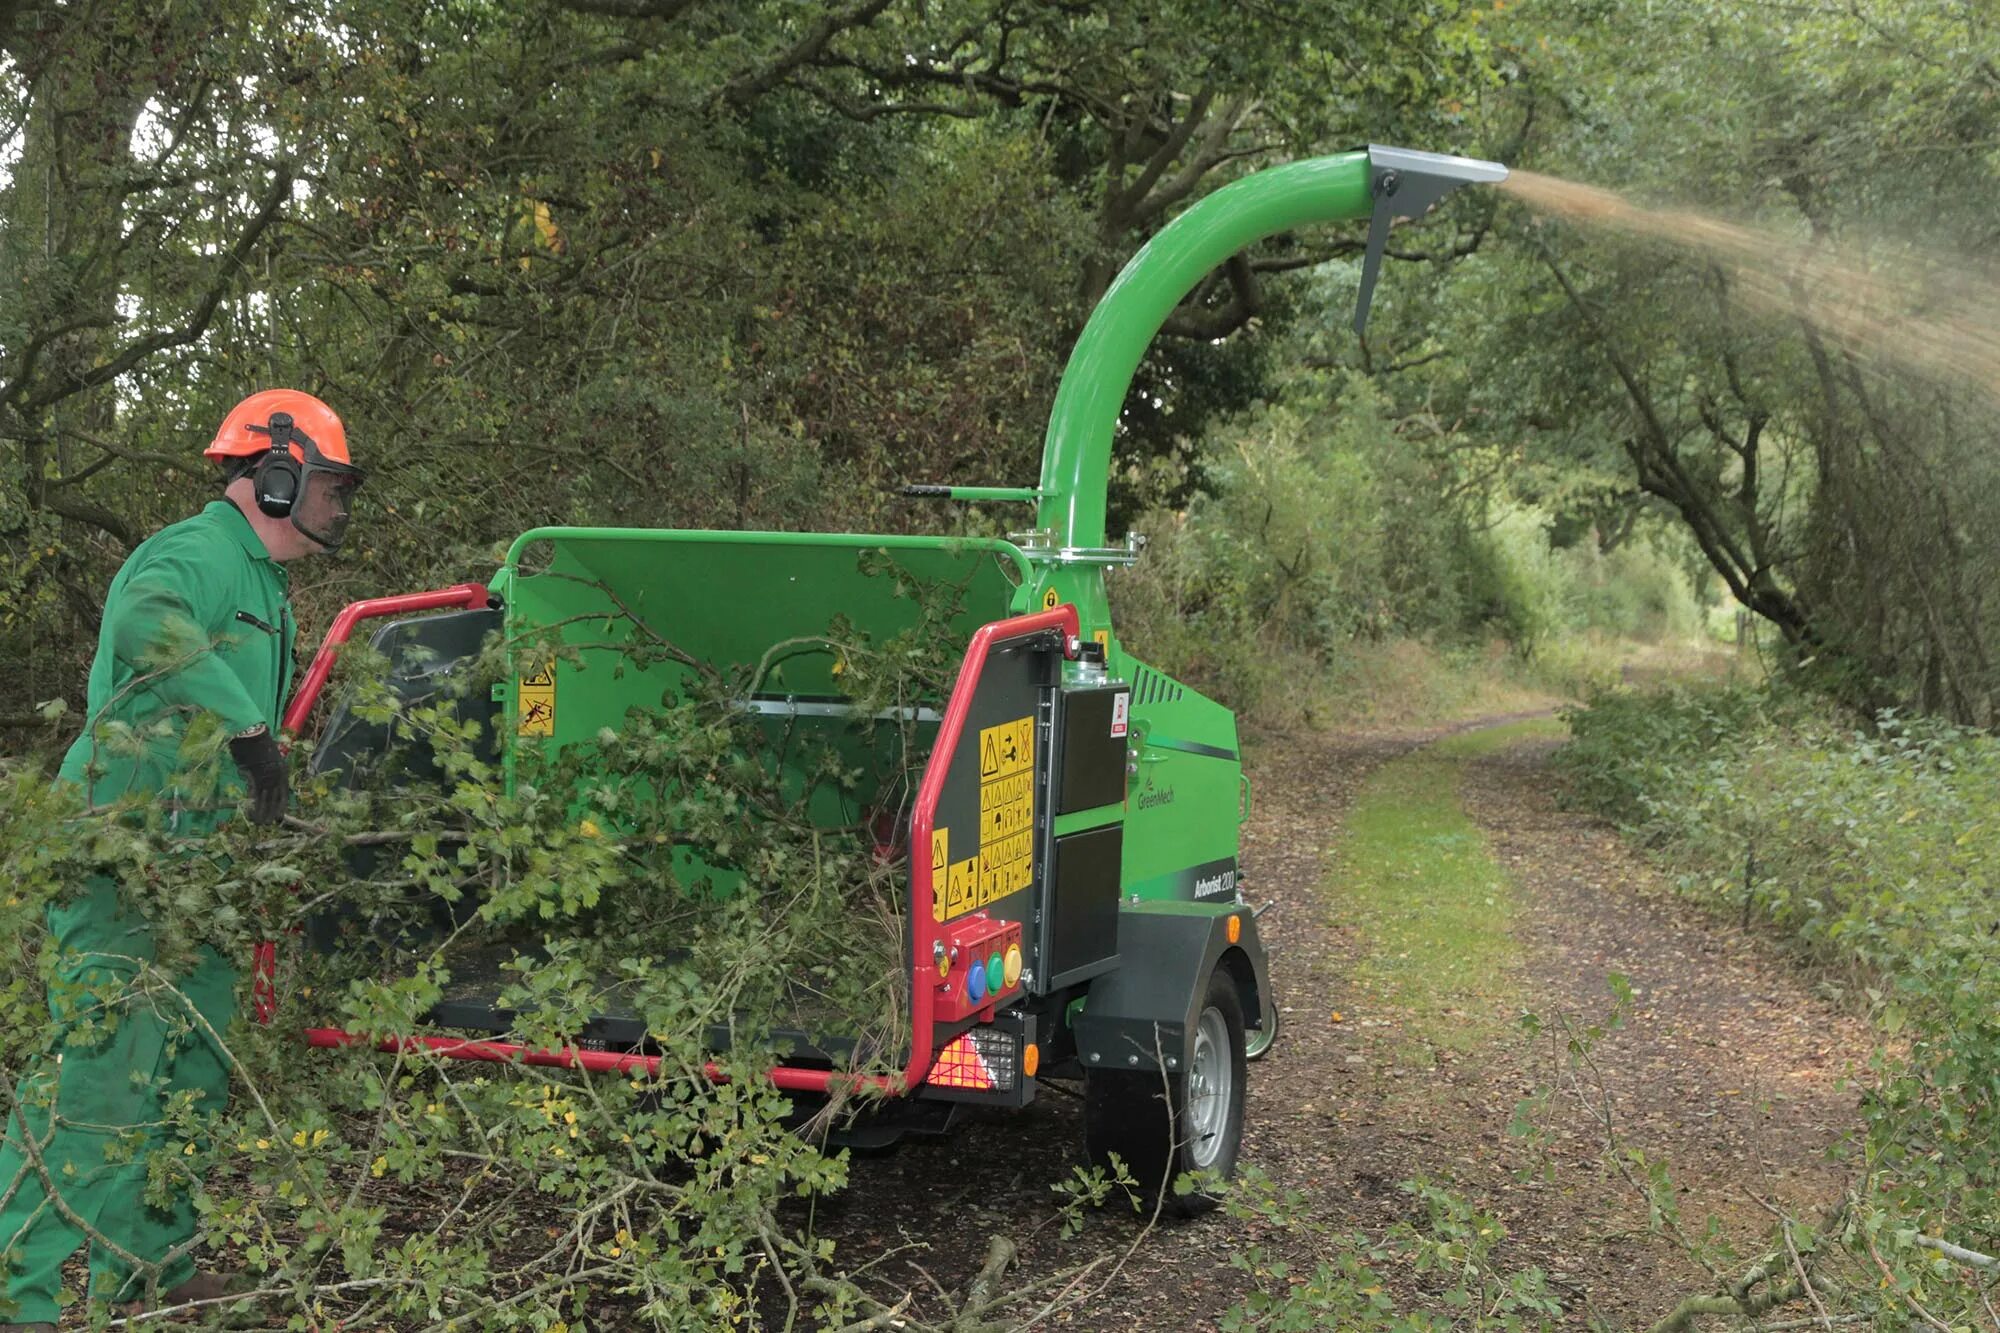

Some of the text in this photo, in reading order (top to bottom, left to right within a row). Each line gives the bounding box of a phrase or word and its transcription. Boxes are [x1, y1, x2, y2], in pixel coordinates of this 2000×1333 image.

[1138, 785, 1174, 810] GreenMech
[1194, 870, 1234, 899] Arborist 200
